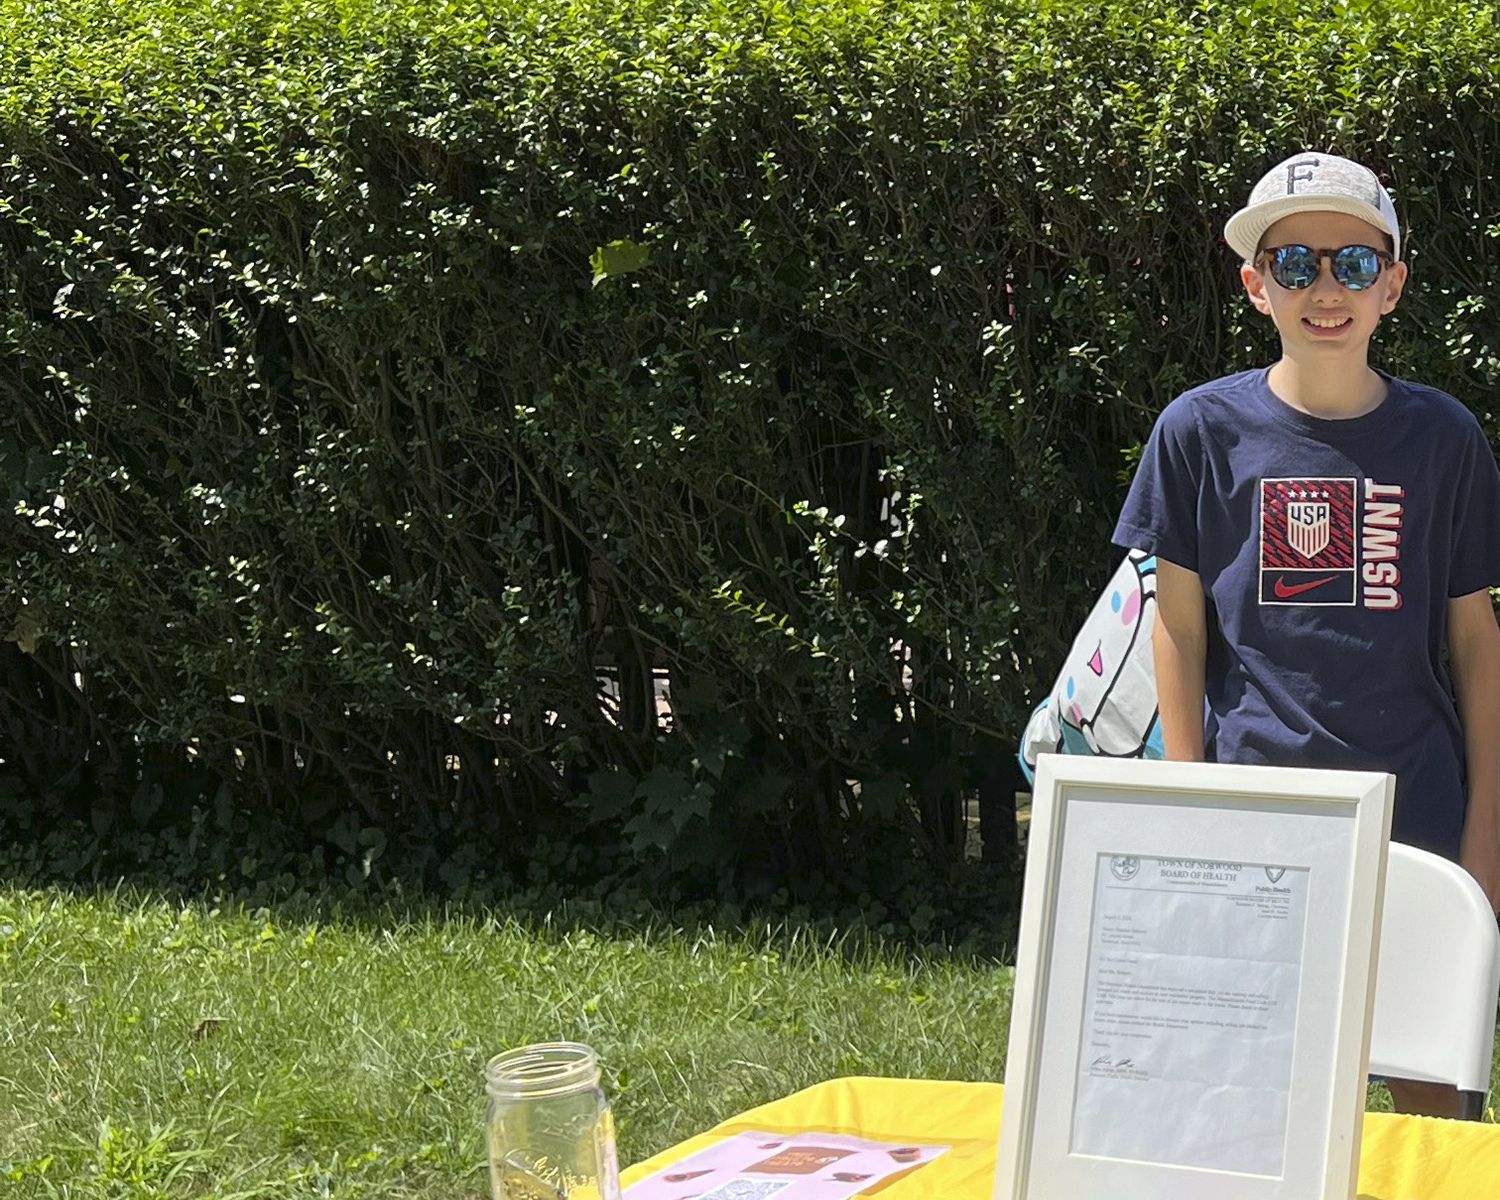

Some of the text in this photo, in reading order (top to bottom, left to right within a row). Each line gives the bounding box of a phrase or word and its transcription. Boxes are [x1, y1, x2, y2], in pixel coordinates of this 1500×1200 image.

[1287, 158, 1320, 195] F
[1290, 506, 1326, 526] USA
[1362, 477, 1405, 610] USWNT
[1160, 869, 1237, 882] BOARD OF HEALTH
